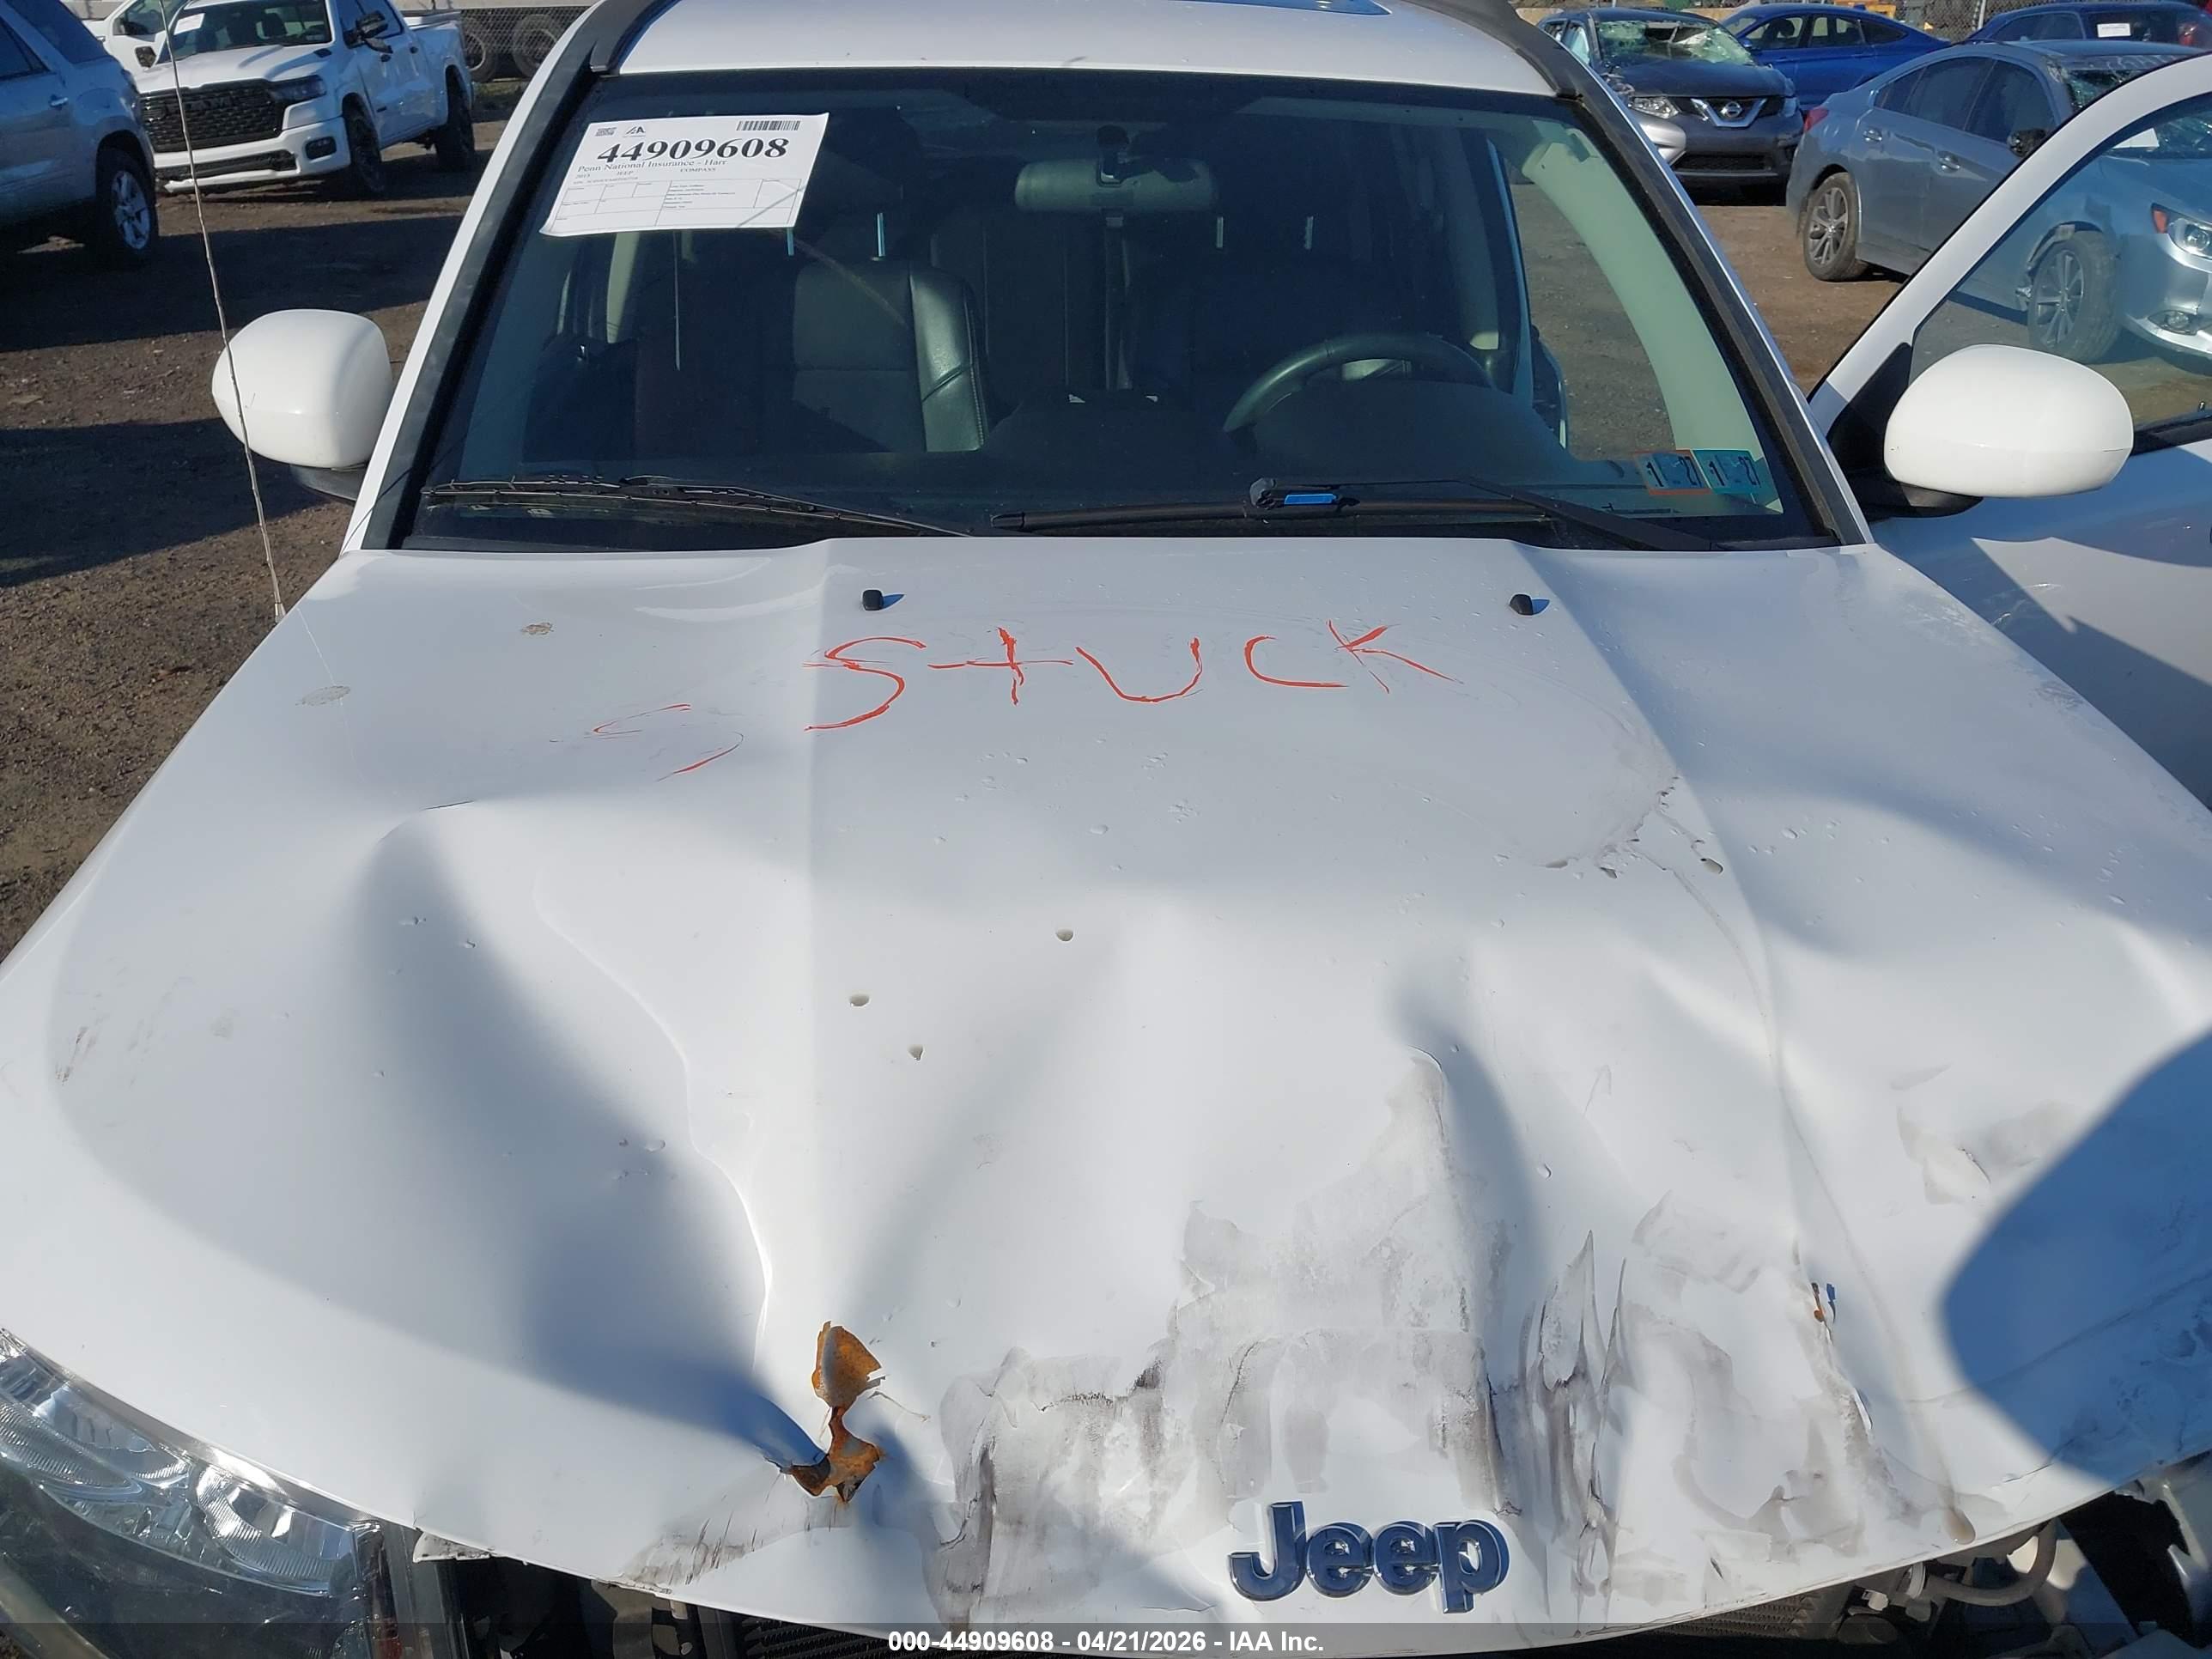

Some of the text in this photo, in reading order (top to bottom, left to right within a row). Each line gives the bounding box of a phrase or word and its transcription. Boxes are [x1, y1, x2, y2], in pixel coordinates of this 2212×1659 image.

[597, 138, 790, 163] 44909608
[604, 161, 645, 171] National
[647, 160, 695, 168] Insurance
[1228, 1501, 1510, 1613] Jeep
